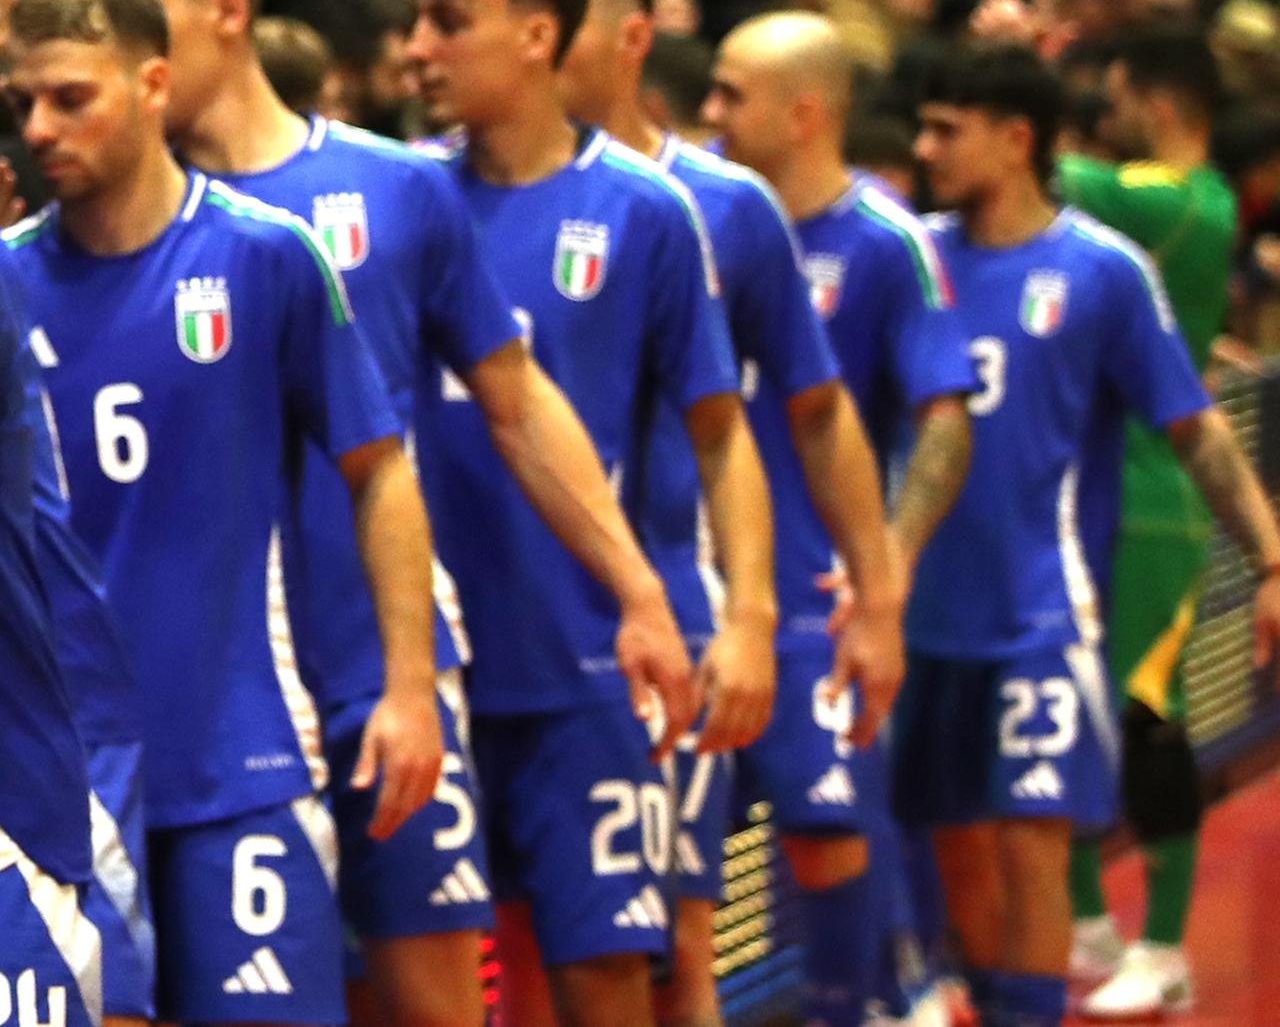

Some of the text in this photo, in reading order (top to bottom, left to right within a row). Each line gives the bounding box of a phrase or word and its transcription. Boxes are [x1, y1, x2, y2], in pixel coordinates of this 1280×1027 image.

[94, 382, 149, 484] 6
[999, 677, 1079, 757] 23
[432, 752, 477, 850] 5
[589, 779, 673, 875] 20
[231, 834, 287, 936] 6
